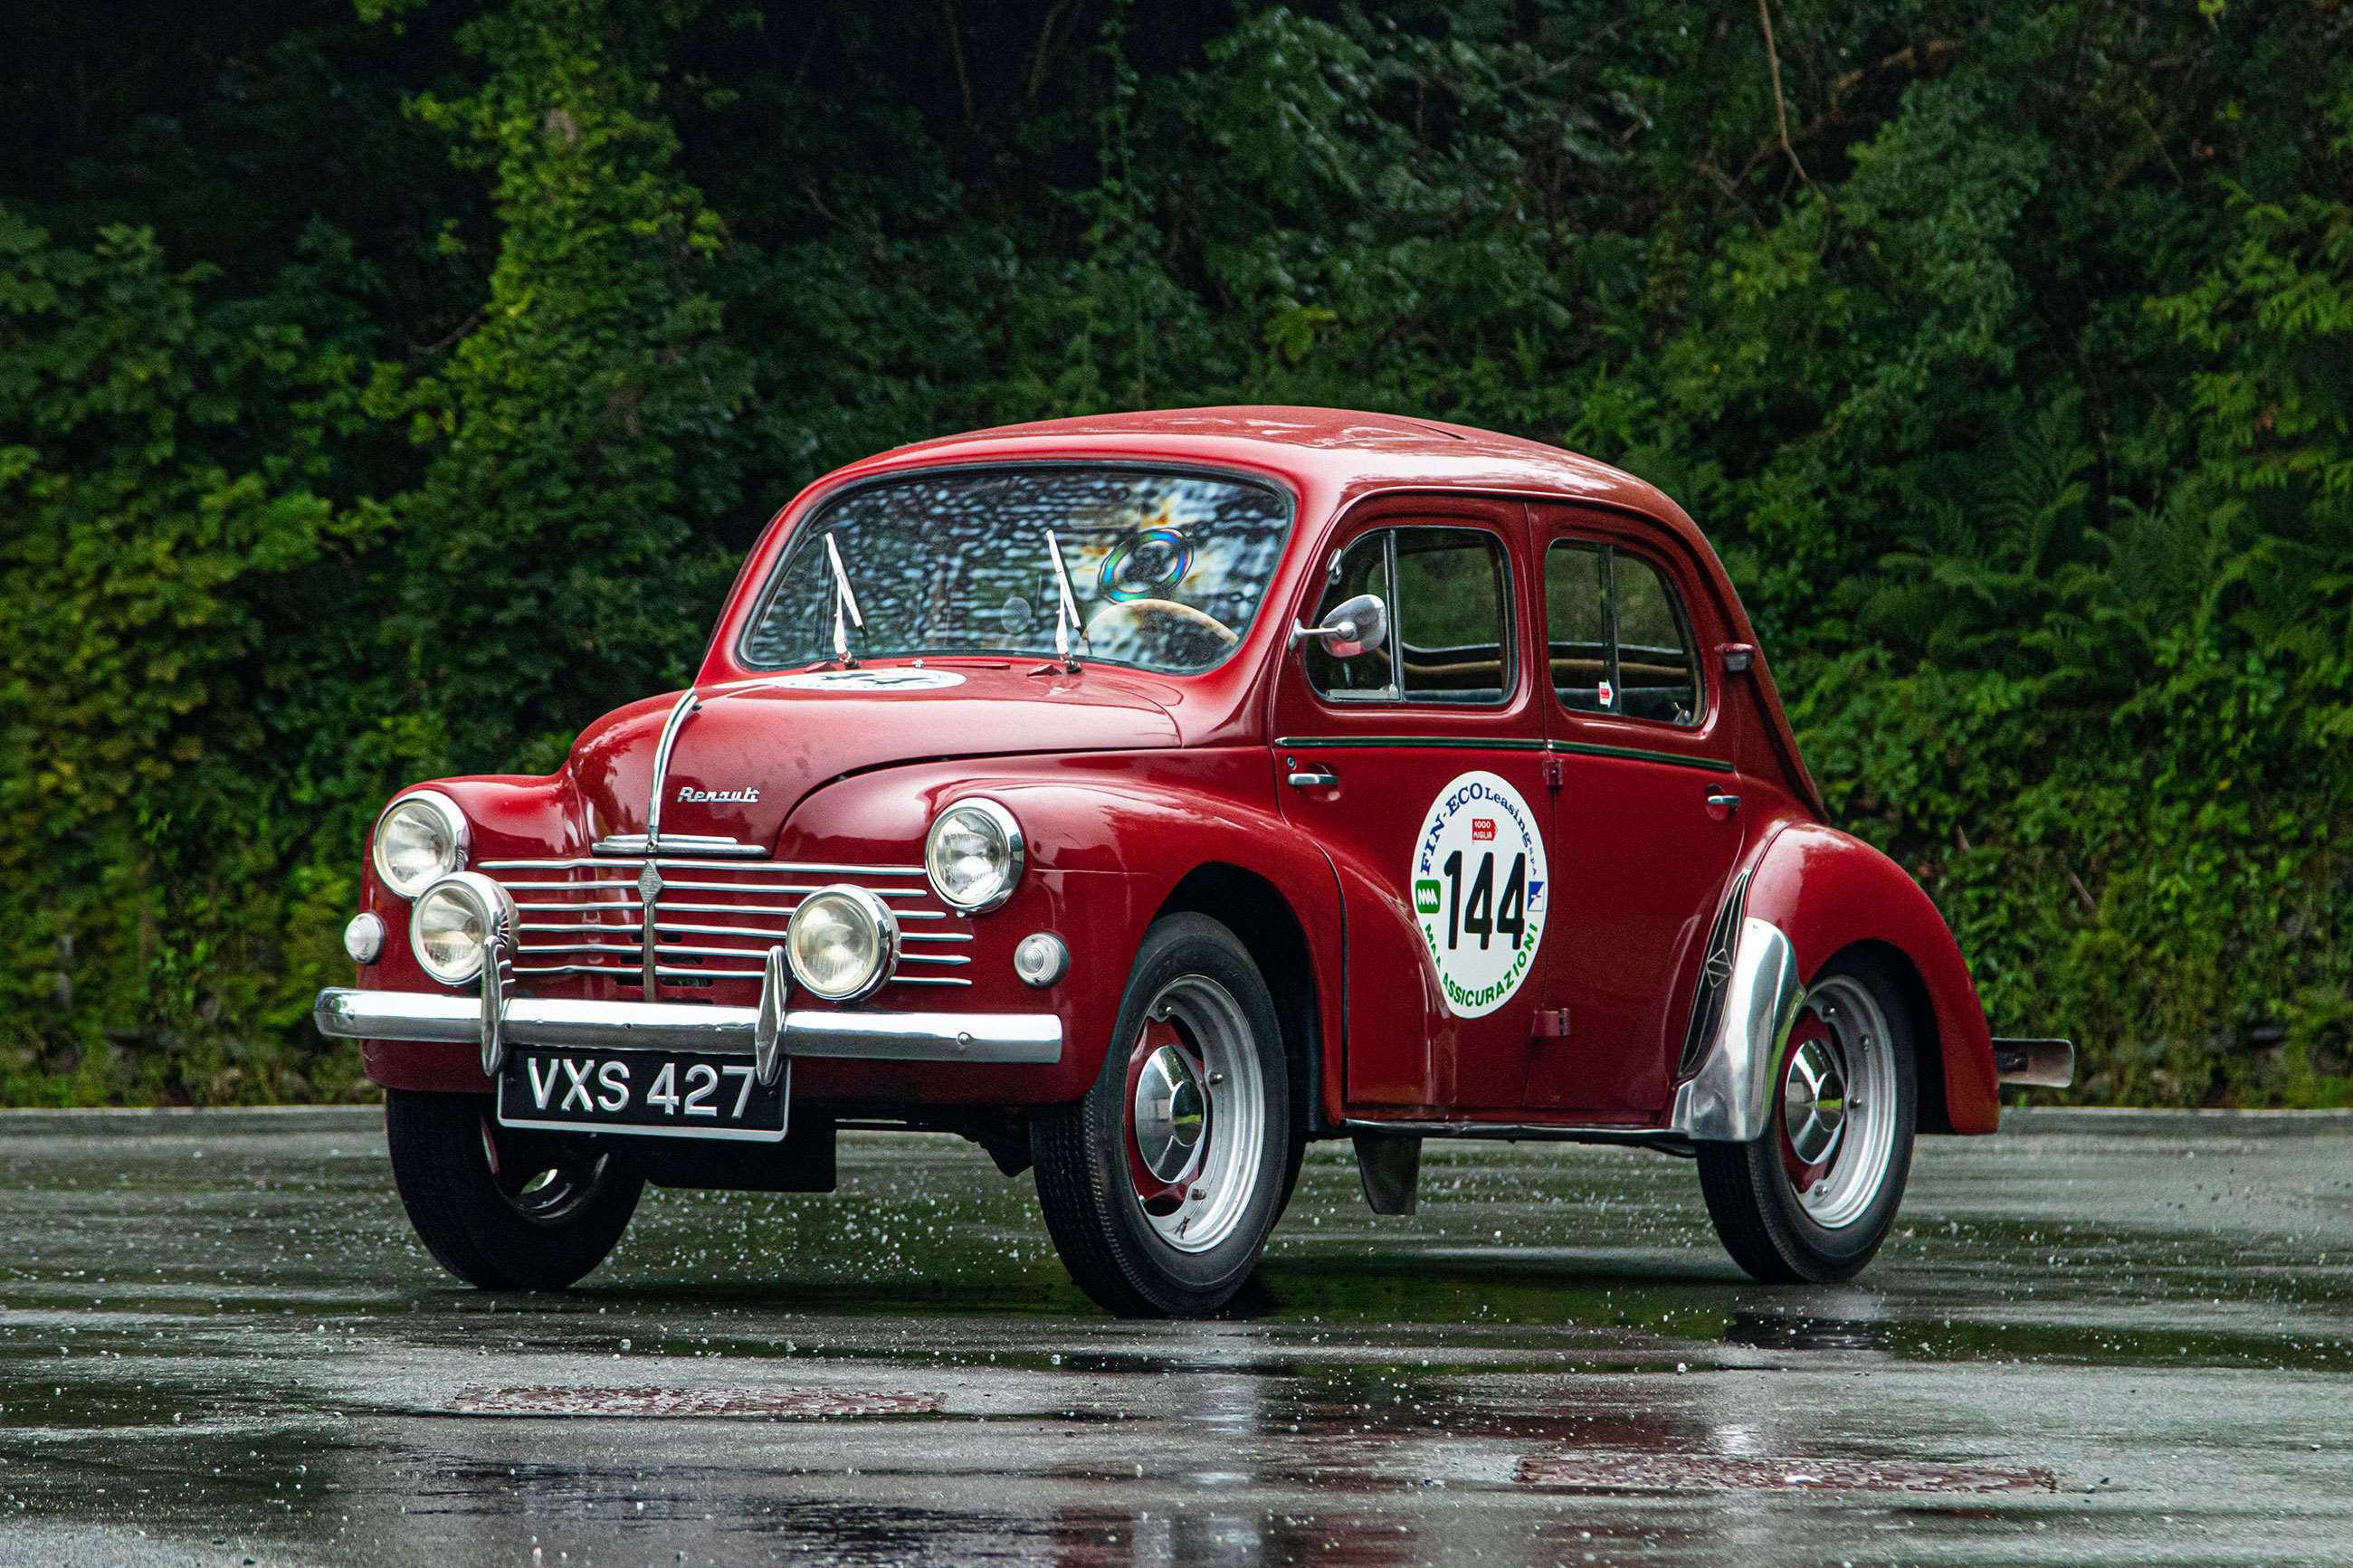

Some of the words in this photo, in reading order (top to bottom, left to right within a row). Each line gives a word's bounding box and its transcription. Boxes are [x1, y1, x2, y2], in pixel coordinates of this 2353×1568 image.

[677, 786, 759, 803] Renault
[1420, 783, 1482, 876] FIN-ECO
[1485, 787, 1531, 848] Leasing
[1443, 851, 1526, 950] 144
[1443, 923, 1538, 1007] ASSICURAZIONI
[528, 1057, 630, 1112] VXS
[646, 1062, 755, 1118] 427
